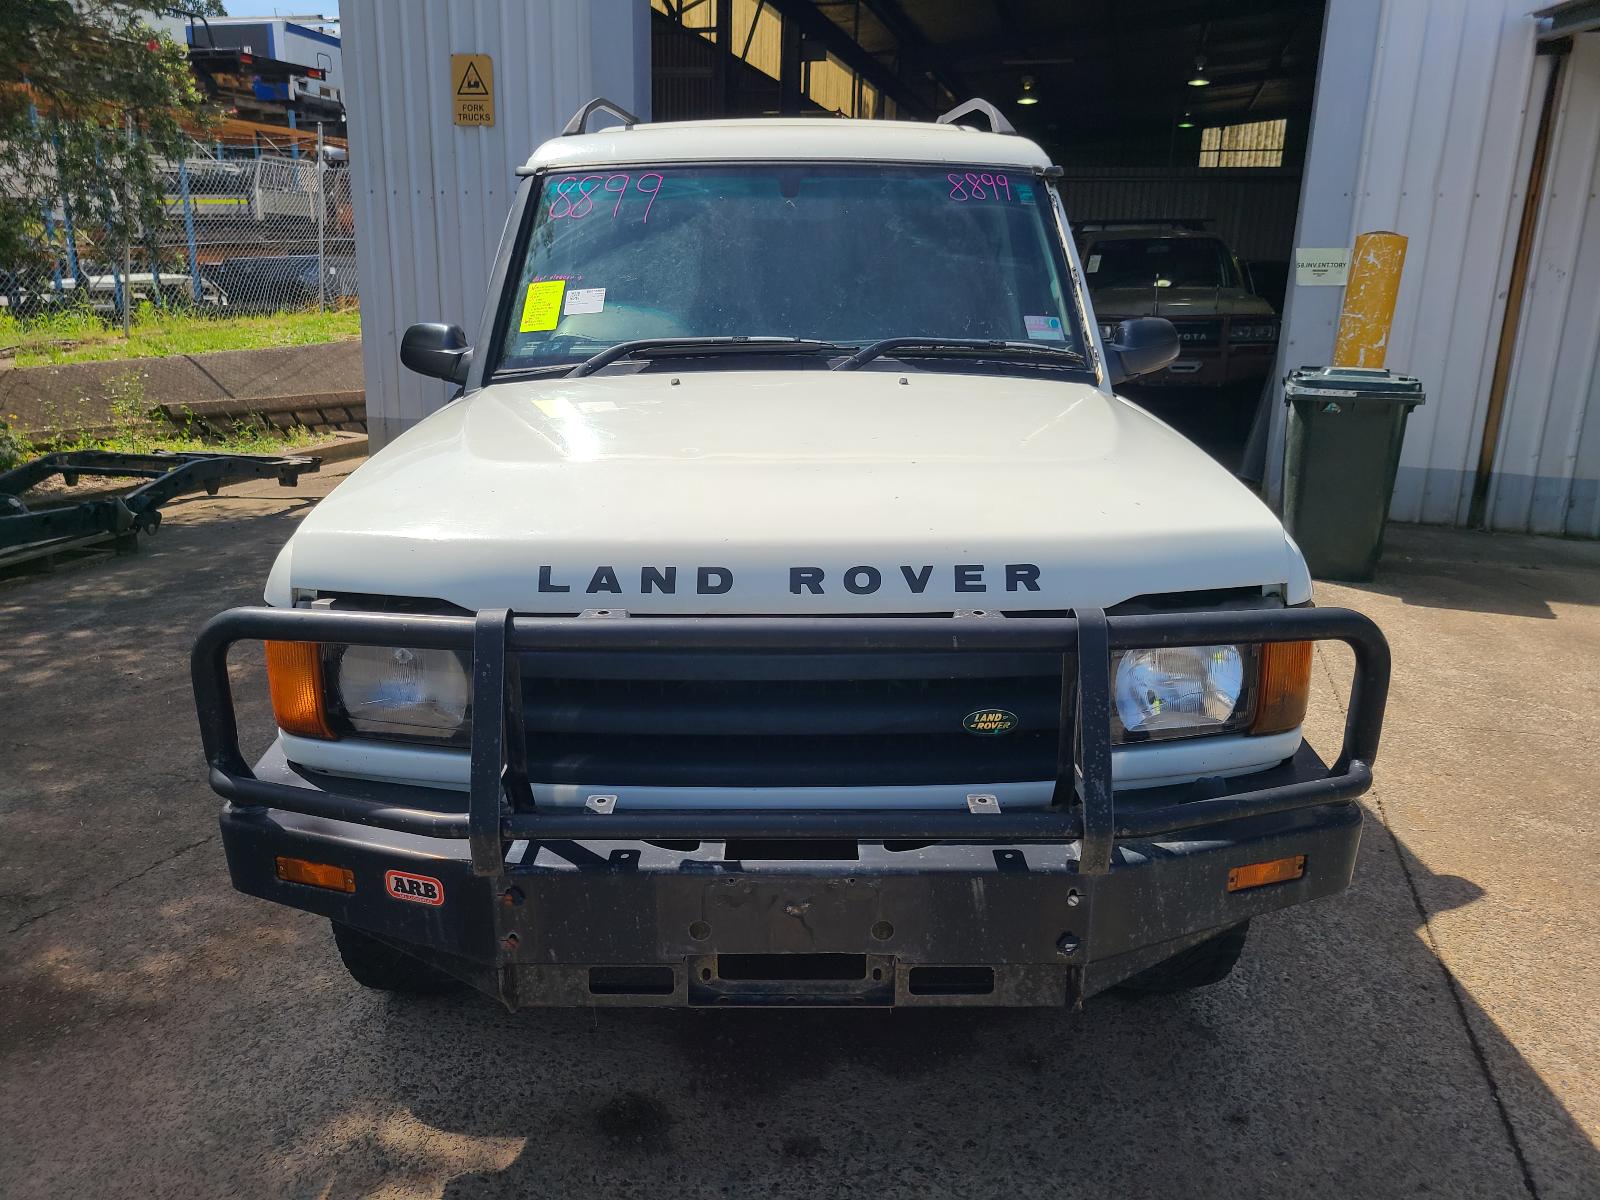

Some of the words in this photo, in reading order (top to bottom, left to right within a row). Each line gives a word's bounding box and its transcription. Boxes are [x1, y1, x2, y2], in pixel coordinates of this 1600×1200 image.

[462, 104, 484, 112] FORK
[458, 113, 491, 122] TRUCKS
[947, 173, 1011, 201] 8899
[549, 173, 664, 224] 8899
[1177, 333, 1207, 341] YOTA
[538, 565, 734, 595] LAND
[789, 563, 1041, 595] ROVER
[974, 713, 1002, 722] LAND
[976, 721, 1011, 730] ROVER
[393, 876, 438, 899] ARB
